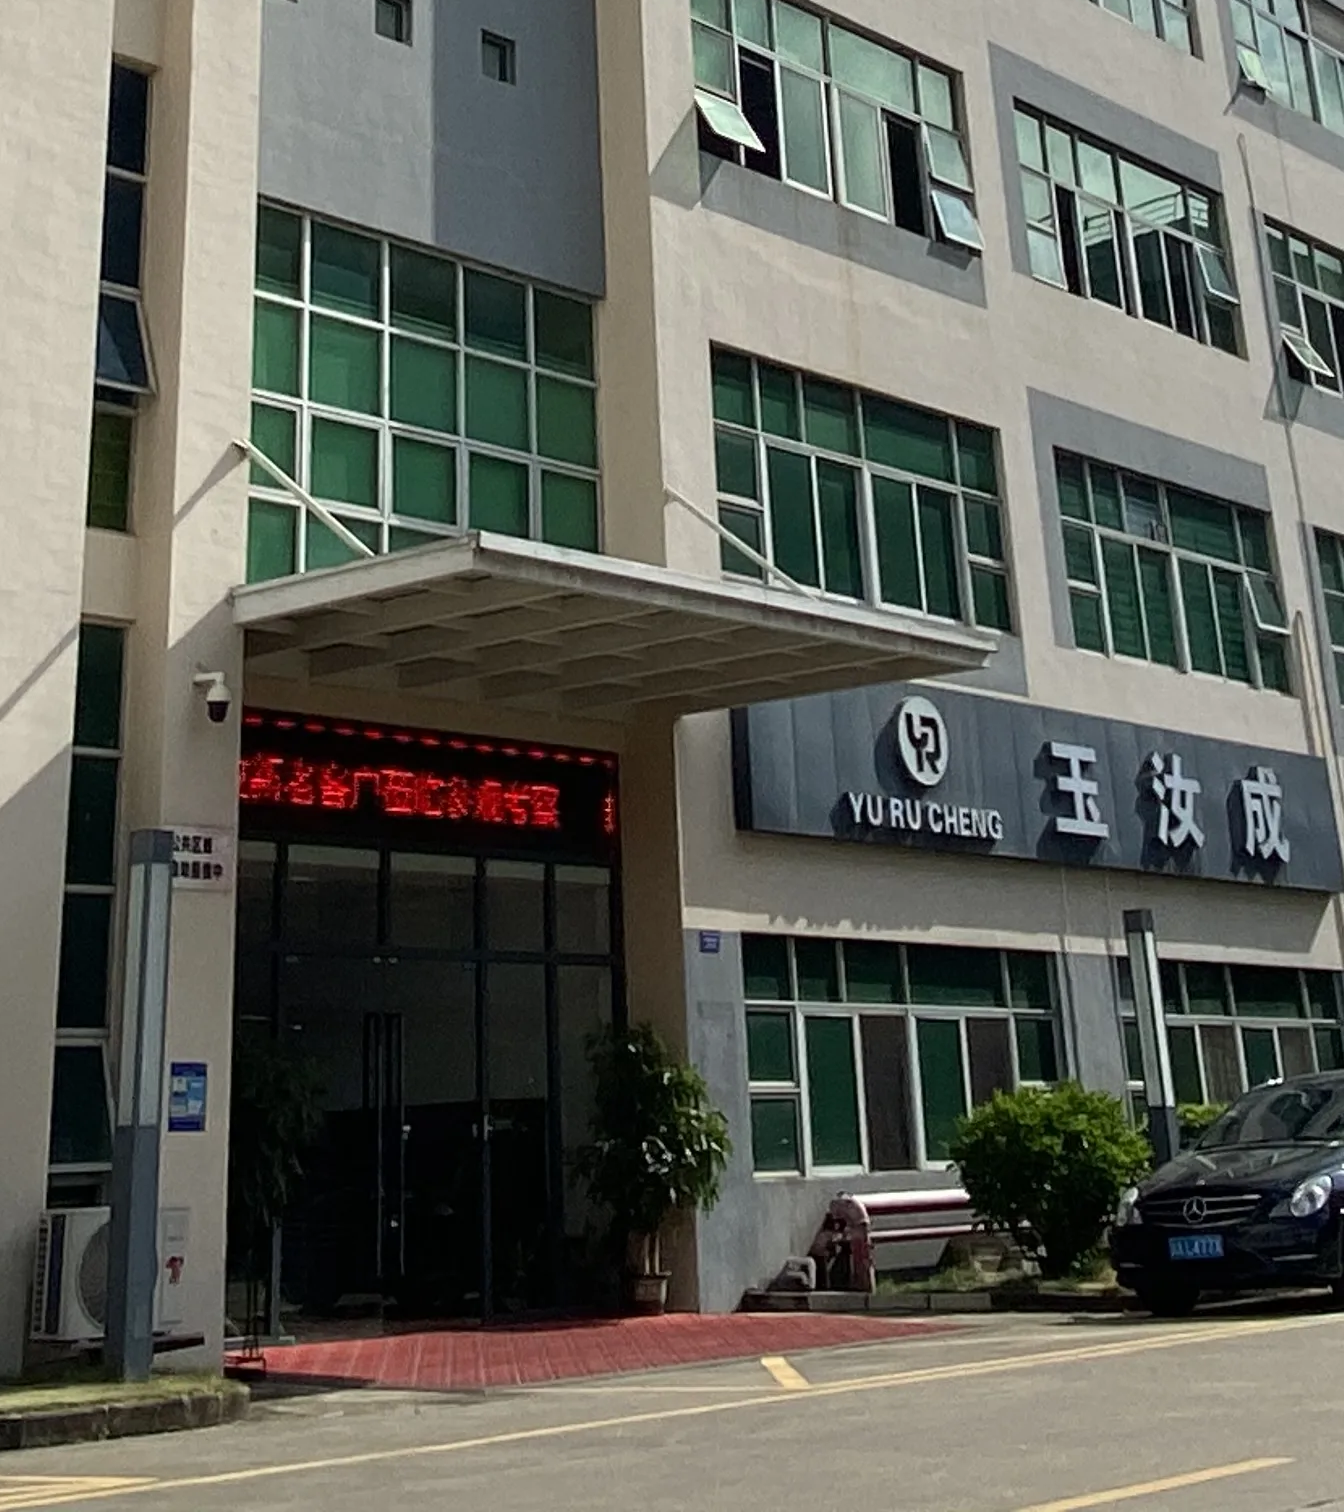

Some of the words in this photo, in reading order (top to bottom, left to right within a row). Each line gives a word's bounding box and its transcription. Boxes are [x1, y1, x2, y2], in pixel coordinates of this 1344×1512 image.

[848, 791, 883, 826] YU
[890, 796, 922, 830] RU
[928, 801, 1004, 840] CHENG
[1051, 741, 1291, 864] 玉汝成
